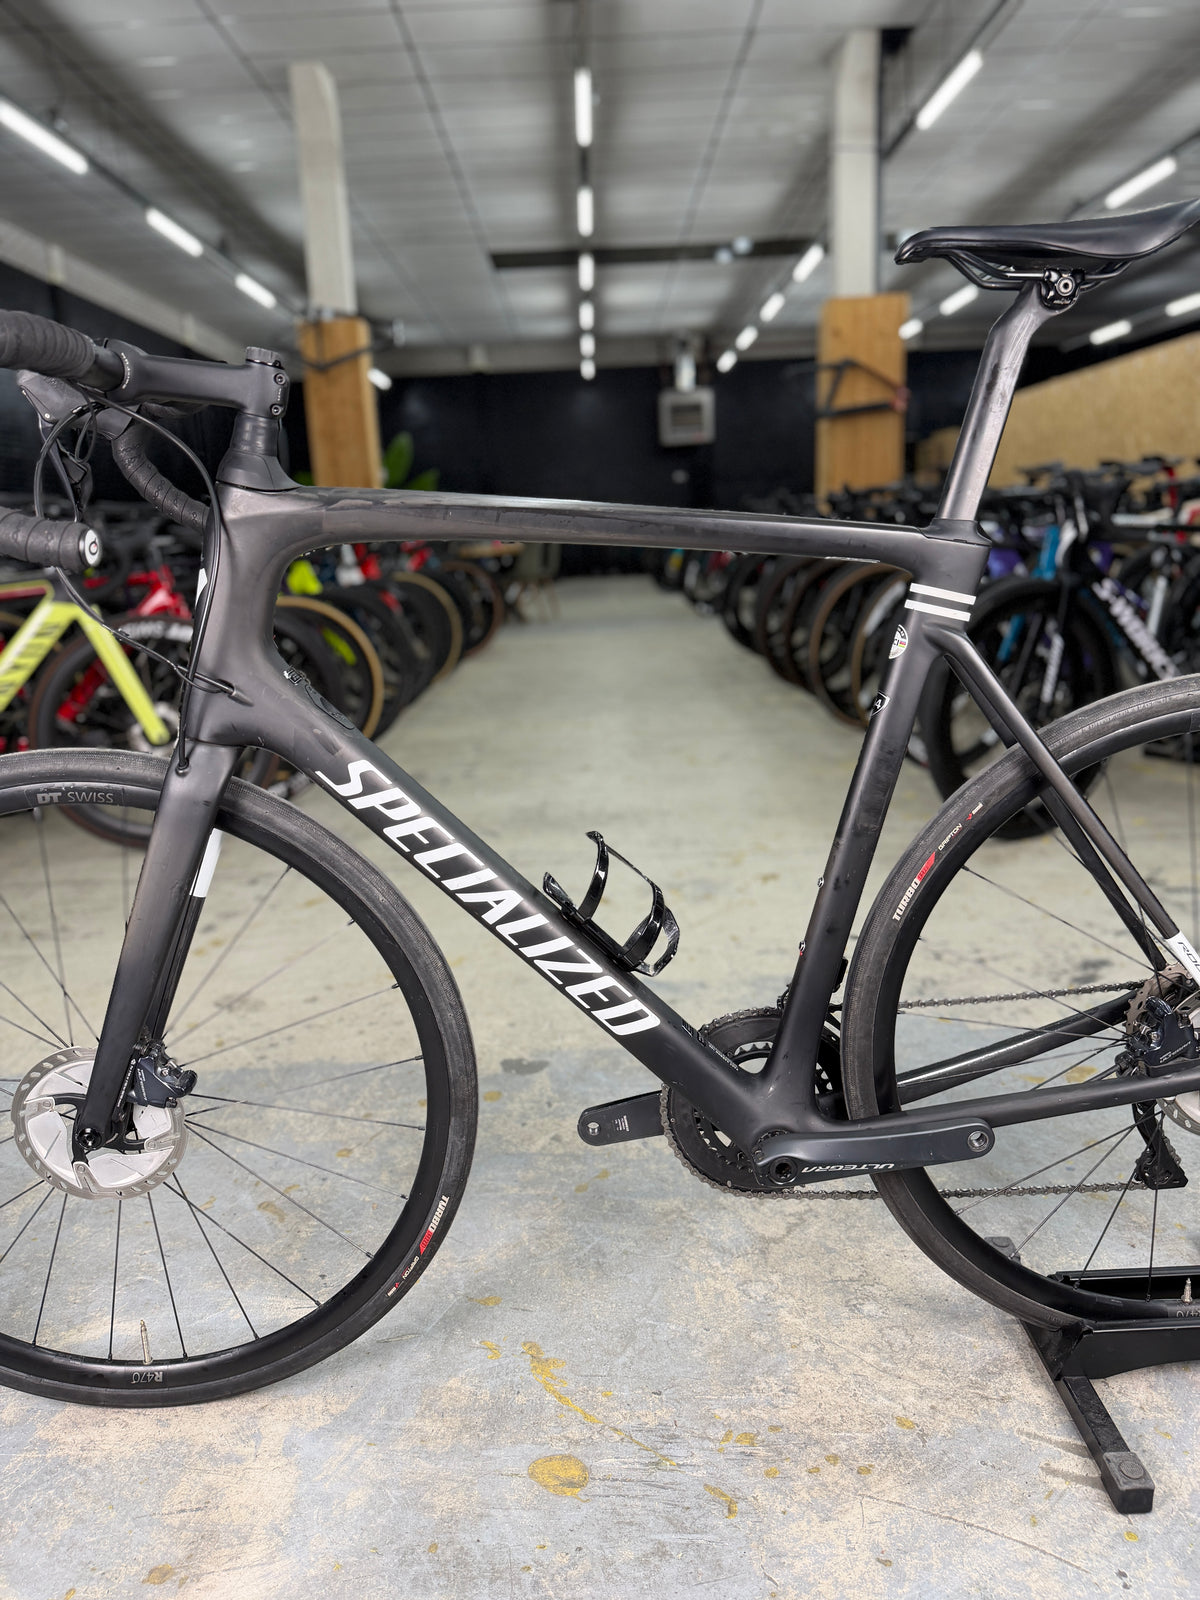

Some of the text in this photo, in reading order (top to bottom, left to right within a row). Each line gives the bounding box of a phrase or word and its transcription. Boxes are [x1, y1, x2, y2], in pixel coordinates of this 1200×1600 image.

[36, 791, 114, 804] DT SWISS
[315, 759, 661, 1036] SPECIALIZED
[892, 878, 920, 921] TURBO
[801, 1163, 895, 1173] ULTEGRA
[428, 1195, 450, 1233] TURBO
[131, 1371, 163, 1384] R470
